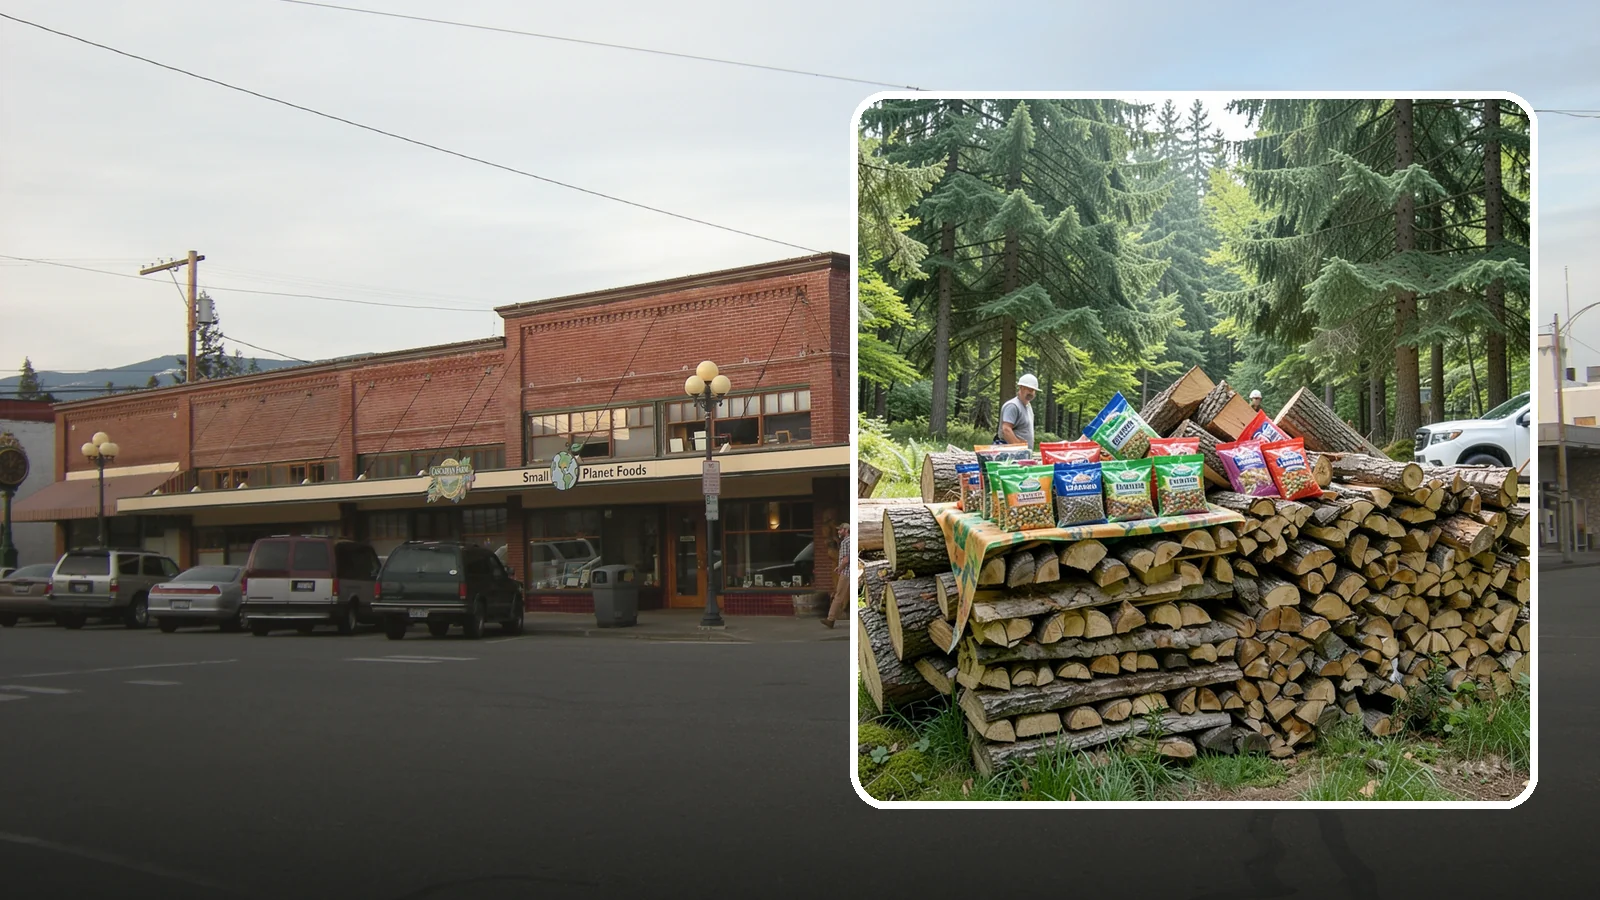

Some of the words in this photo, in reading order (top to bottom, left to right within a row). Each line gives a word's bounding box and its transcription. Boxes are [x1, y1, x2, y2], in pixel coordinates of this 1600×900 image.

[455, 465, 469, 474] FARM
[523, 470, 549, 483] Small
[582, 467, 614, 479] Planet
[616, 464, 647, 477] Foods
